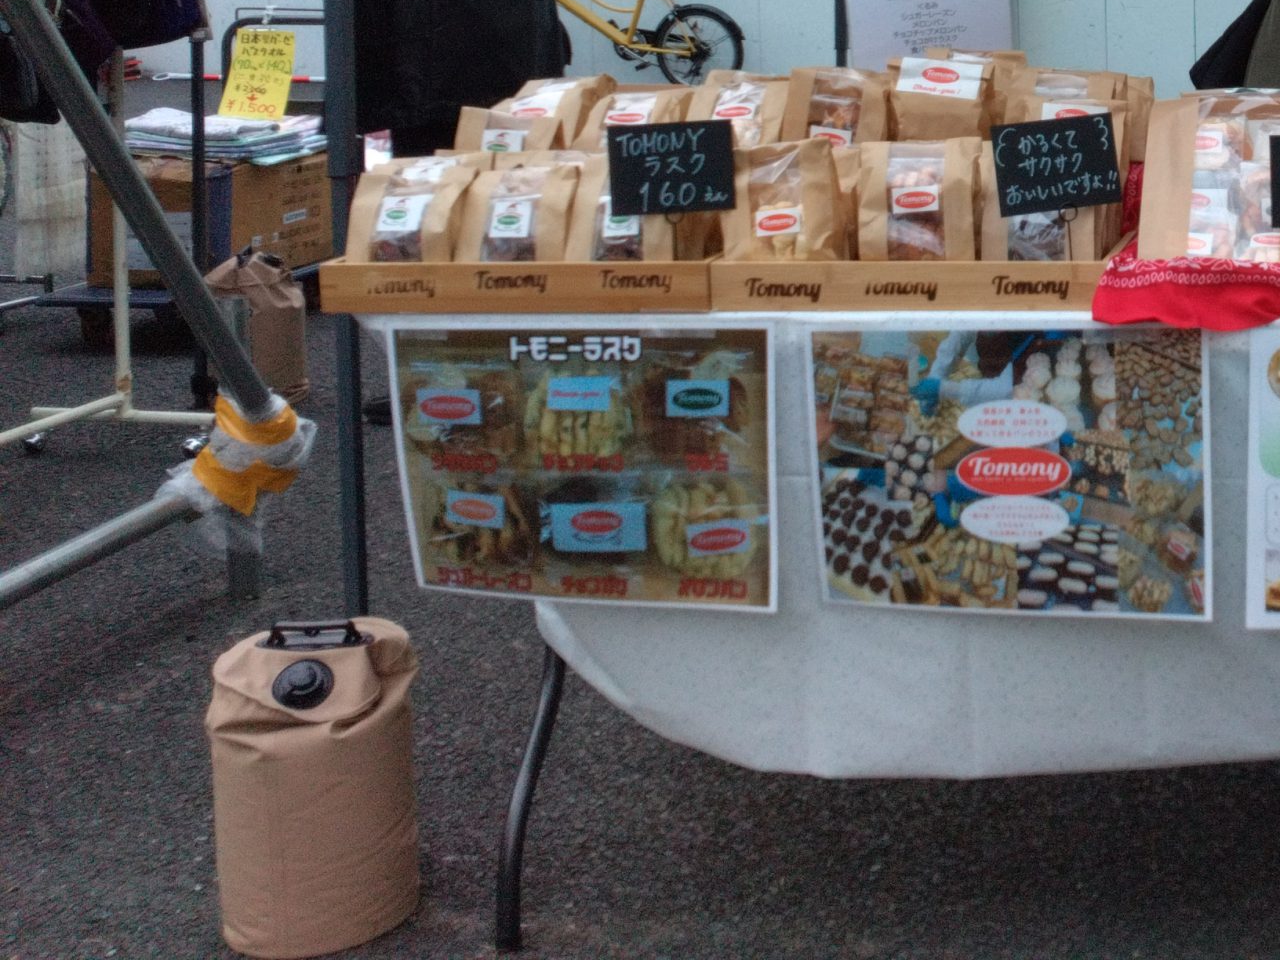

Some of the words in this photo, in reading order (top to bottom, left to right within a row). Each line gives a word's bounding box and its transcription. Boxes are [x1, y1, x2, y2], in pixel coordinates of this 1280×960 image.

[917, 1, 939, 9] くるみ
[911, 18, 947, 29] メロンパン
[926, 69, 959, 80] Tomony
[616, 127, 706, 157] TOMONY
[1018, 130, 1078, 156] かるくて
[645, 154, 706, 178] ラスク
[1017, 152, 1083, 177] サクサク
[898, 194, 935, 206] Tomony
[474, 270, 548, 293] Tomony
[601, 270, 672, 293] Tomony
[746, 278, 821, 302] Tomony
[992, 276, 1070, 300] Tomony
[509, 335, 642, 362] トモニーラスク
[968, 456, 1062, 482] Tomony
